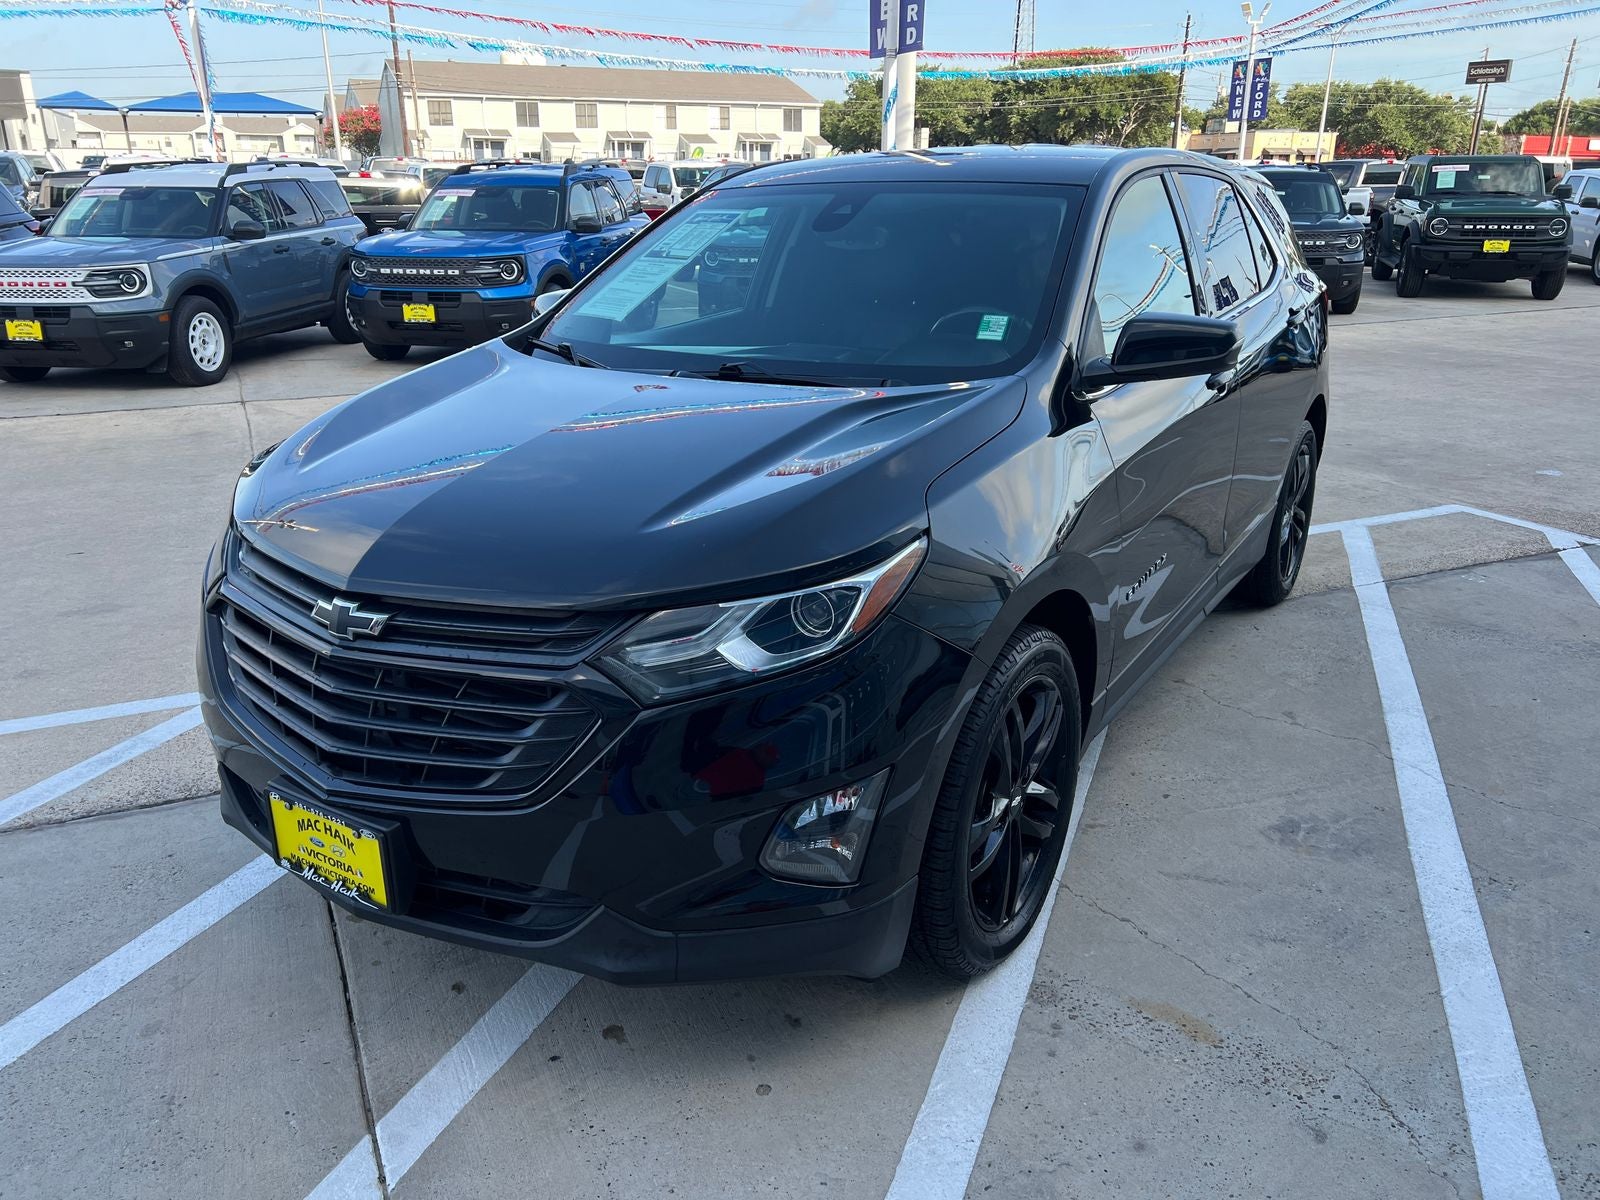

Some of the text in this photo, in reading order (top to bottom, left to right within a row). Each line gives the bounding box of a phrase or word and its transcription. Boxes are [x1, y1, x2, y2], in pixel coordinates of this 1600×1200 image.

[1232, 85, 1244, 119] NEW
[1253, 82, 1265, 118] FORD
[297, 818, 356, 855] MAC HAIK
[301, 866, 330, 888] Mac
[305, 846, 355, 876] VICTORIA
